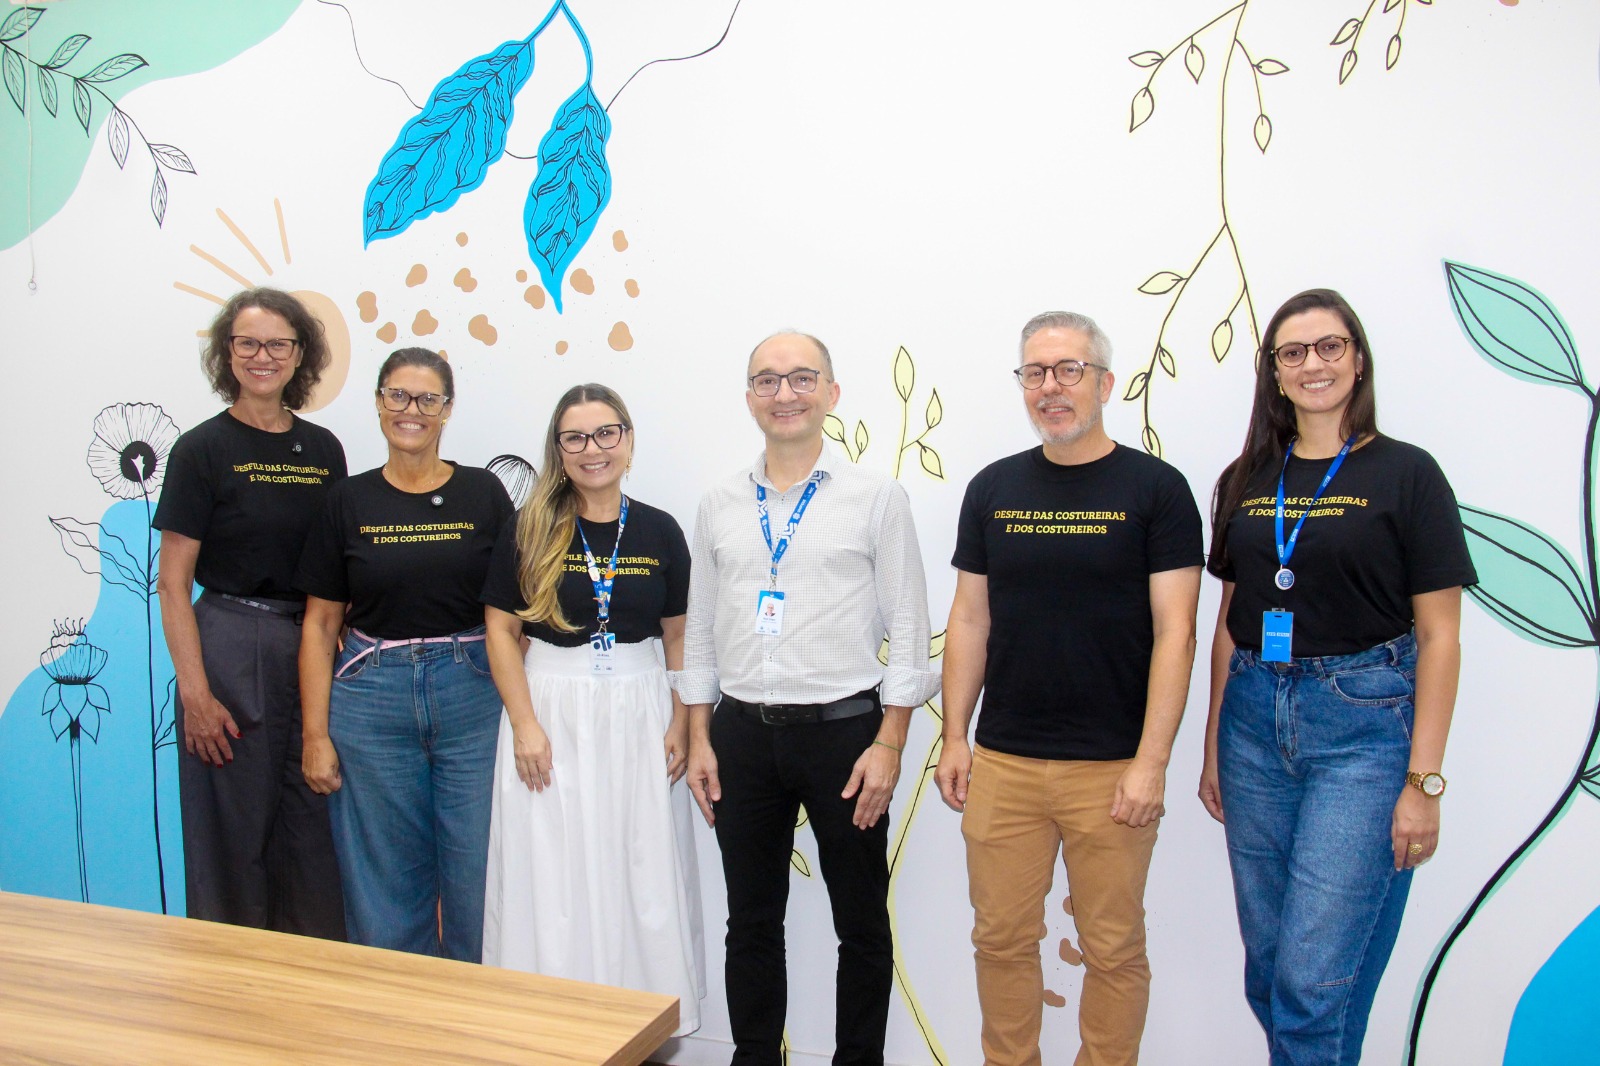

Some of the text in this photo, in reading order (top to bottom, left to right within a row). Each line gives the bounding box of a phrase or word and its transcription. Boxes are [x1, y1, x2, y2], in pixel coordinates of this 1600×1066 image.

[233, 463, 329, 475] DESFILE DAS COSTUREIRAS
[249, 474, 256, 482] E
[256, 474, 272, 483] DOS
[1241, 496, 1278, 507] DESFILE
[1283, 497, 1299, 505] AS
[994, 510, 1126, 521] DESFILE DAS COSTUREIRAS
[1247, 508, 1255, 516] E
[1255, 508, 1277, 517] DOS
[360, 521, 475, 534] DESFILE DAS COSTUREIRAS
[1005, 524, 1108, 535] E DOS COSTUREIROS
[373, 533, 461, 544] E DOS COSTUREIROS
[568, 564, 587, 573] DOS
